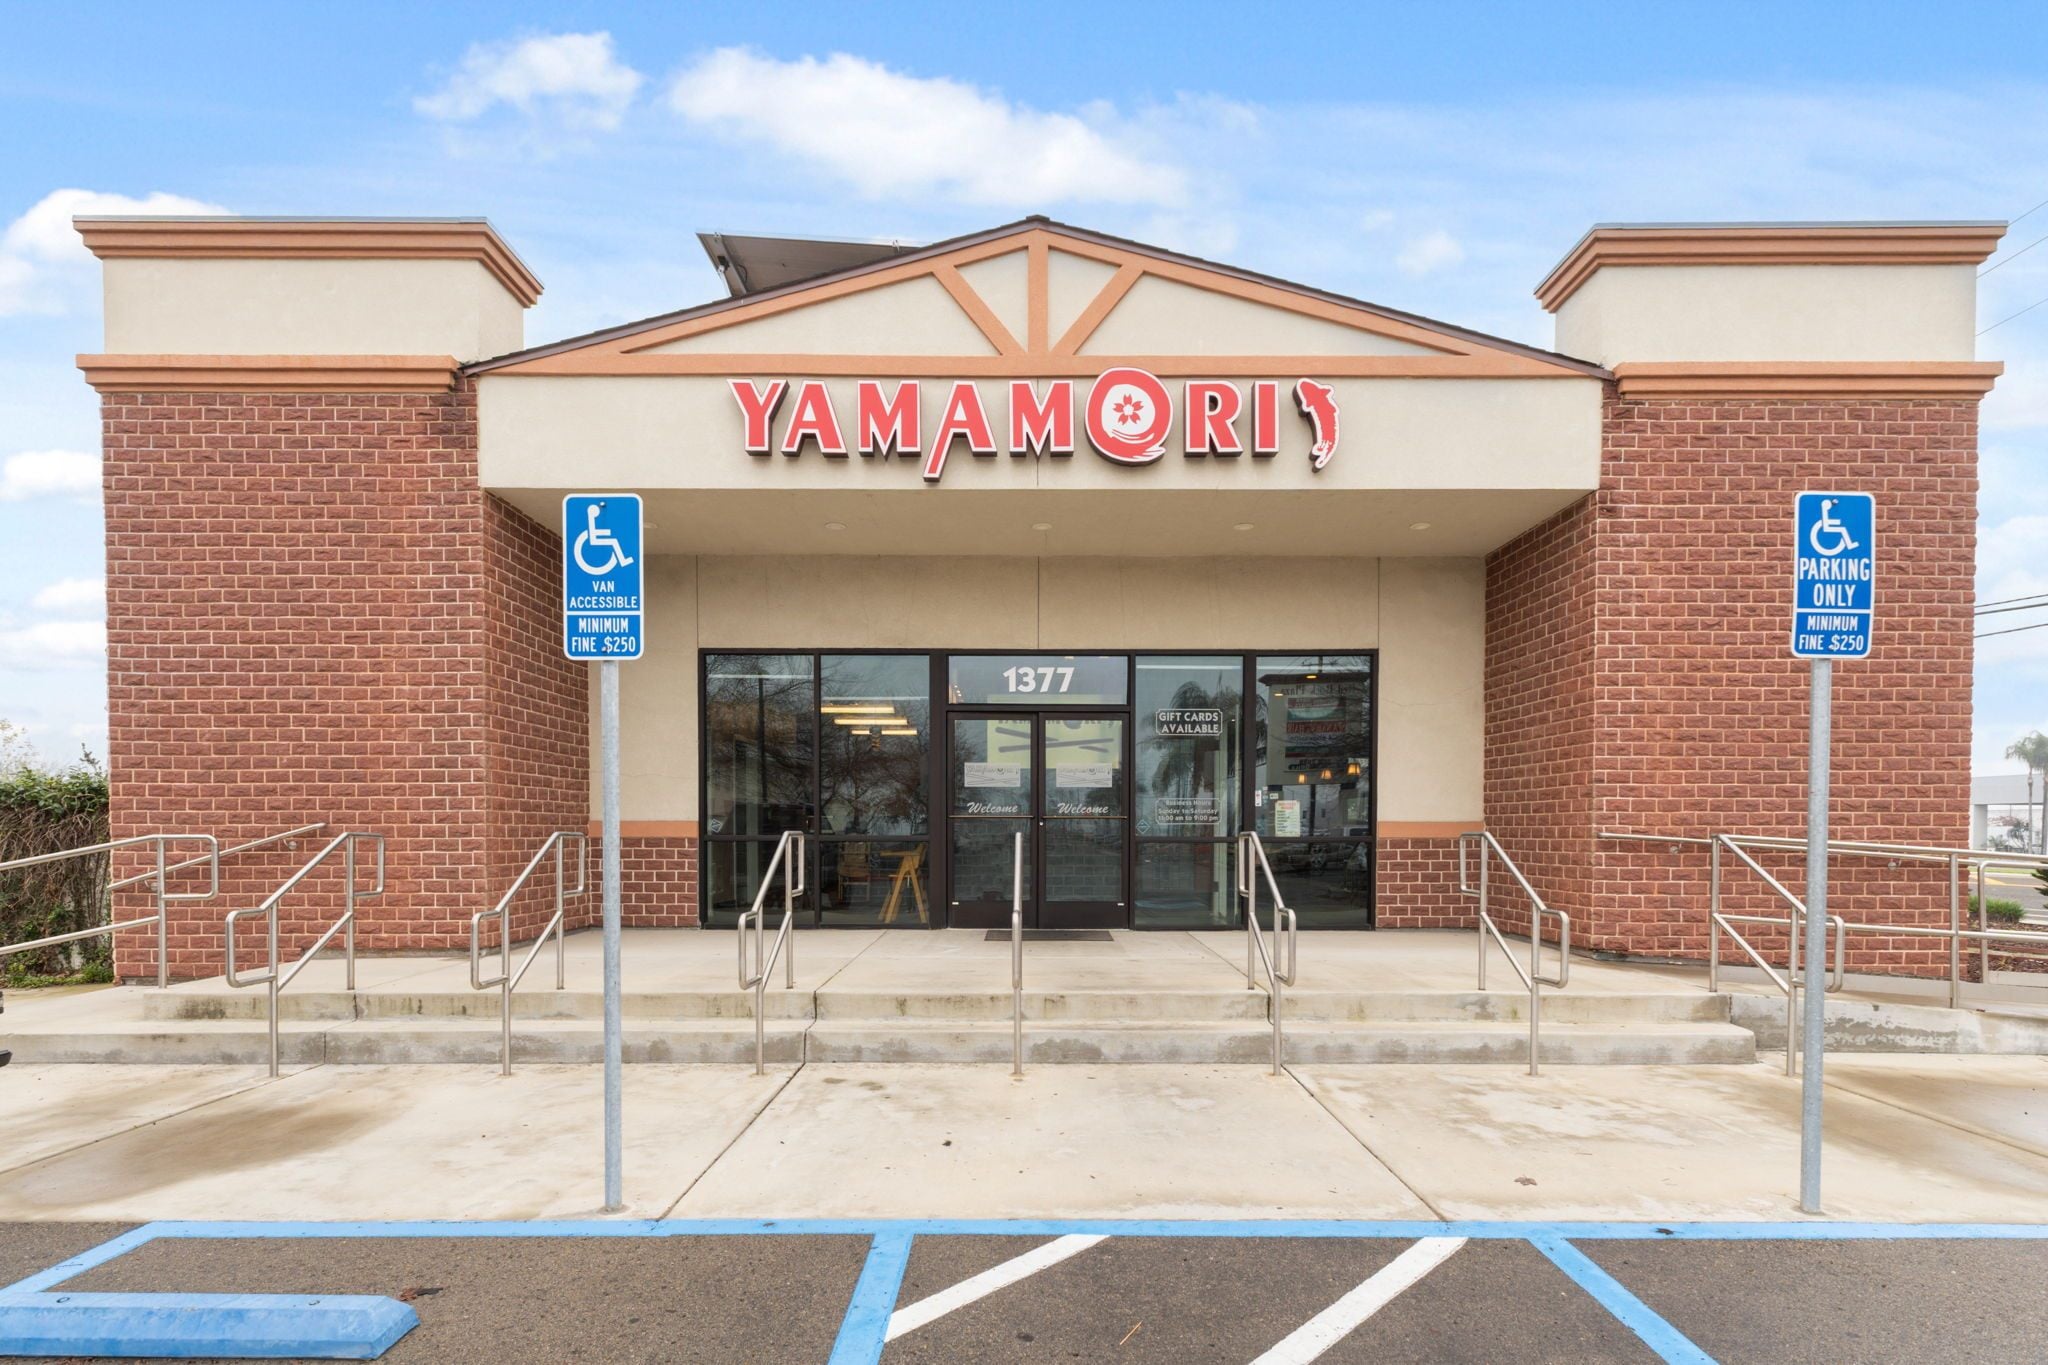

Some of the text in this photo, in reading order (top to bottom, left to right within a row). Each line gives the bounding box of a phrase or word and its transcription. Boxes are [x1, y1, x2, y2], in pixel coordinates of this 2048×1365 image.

[727, 366, 1279, 483] YAMAMORI
[1799, 557, 1871, 581] PARKING
[592, 580, 615, 592] VAN
[569, 596, 638, 608] ACCESSIBLE
[1813, 583, 1857, 607] ONLY
[578, 617, 629, 633] MINIMUM
[1807, 615, 1859, 632] MINIMUM
[571, 635, 636, 654] FINE $250
[1798, 633, 1864, 652] FINE $250
[1002, 666, 1075, 693] 1377
[1159, 712, 1219, 721] GIFT CARDS
[1161, 724, 1219, 733] AVAILABLE
[967, 801, 1018, 813] Welcome
[1057, 802, 1109, 814] Welcome
